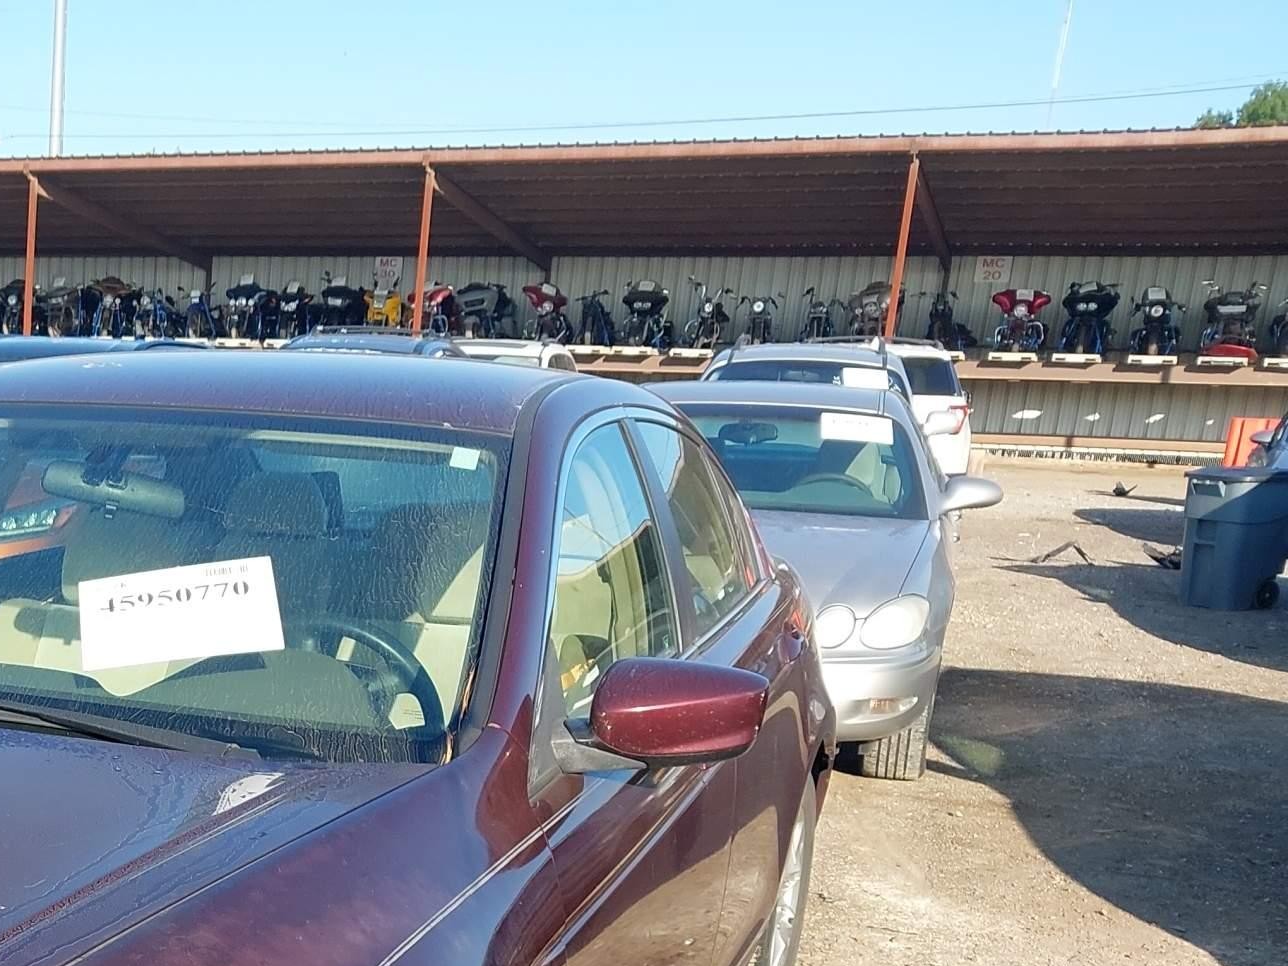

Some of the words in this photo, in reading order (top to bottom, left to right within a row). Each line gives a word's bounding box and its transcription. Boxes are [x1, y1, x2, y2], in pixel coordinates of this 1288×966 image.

[380, 258, 397, 267] MC
[982, 258, 1006, 268] MC
[983, 270, 1002, 280] 20
[99, 580, 250, 613] 45950770
